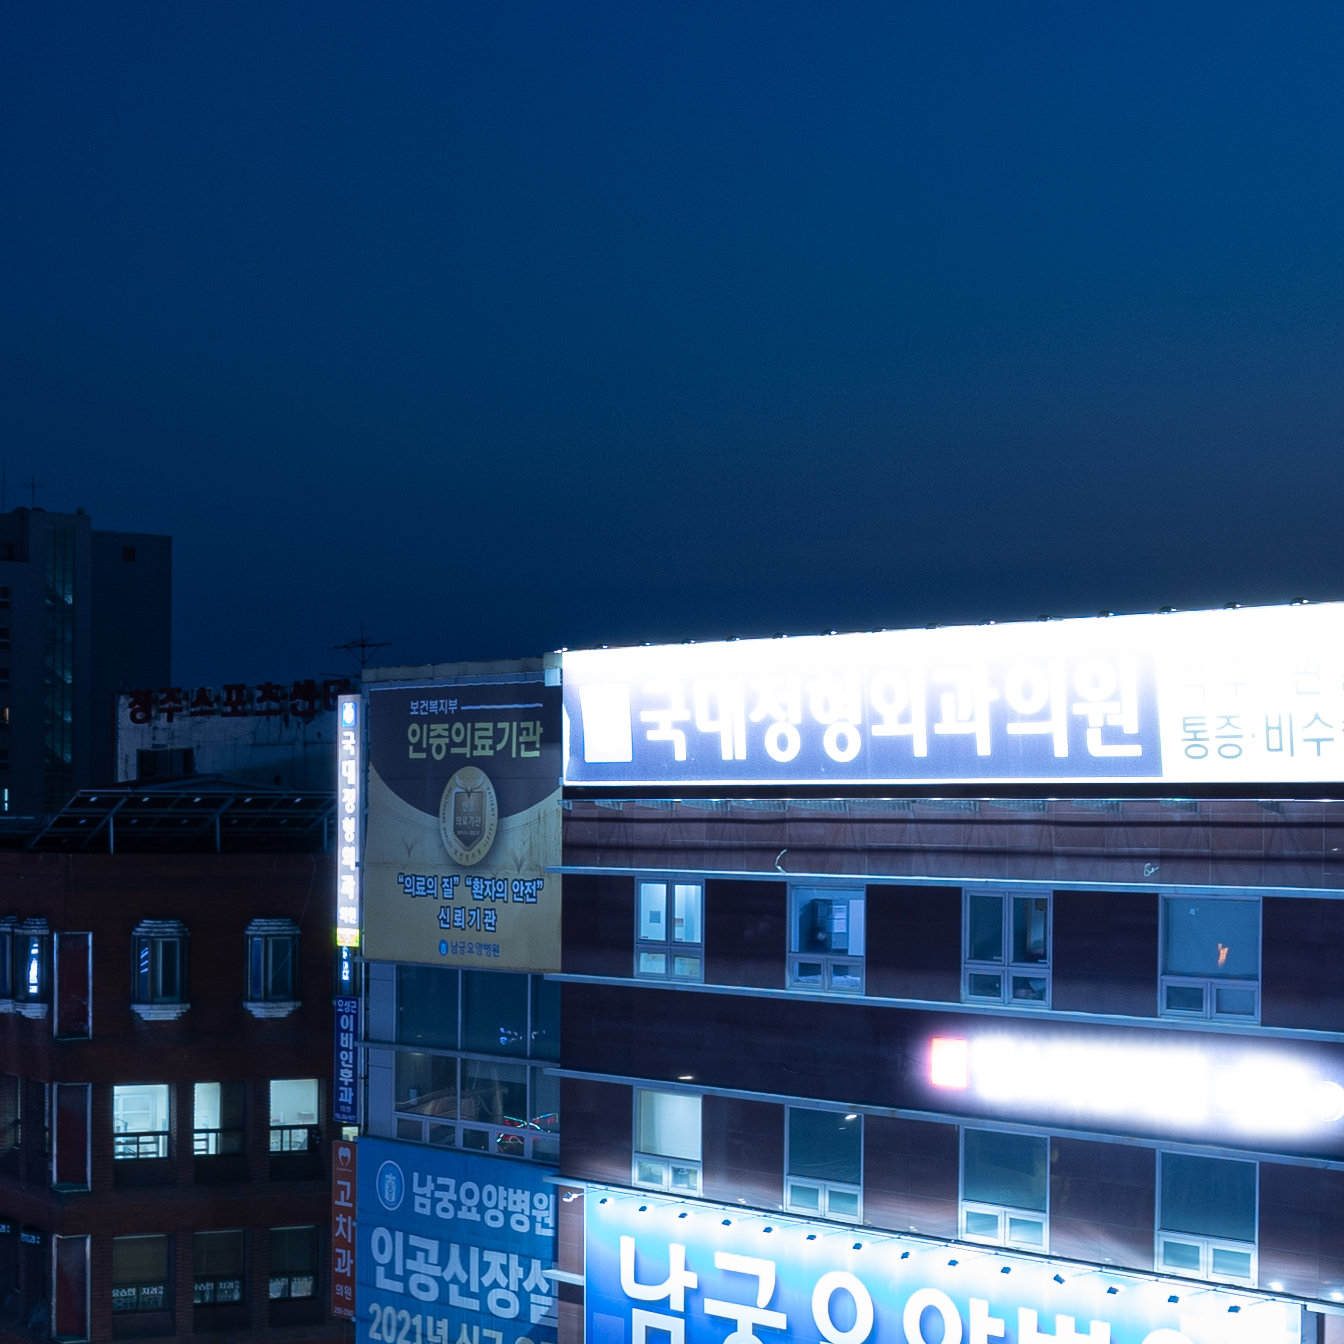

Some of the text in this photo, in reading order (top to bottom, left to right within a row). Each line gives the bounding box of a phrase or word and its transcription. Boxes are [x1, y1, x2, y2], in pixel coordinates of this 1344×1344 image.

[410, 699, 458, 716] 보건복지부
[640, 656, 1143, 762] 국대정형외과의원
[408, 720, 544, 761] 인증의료기관
[462, 802, 475, 813] 인증
[455, 815, 482, 828] 의료기관
[398, 873, 544, 904] “의료의 질” “환자의 안전”
[438, 906, 497, 931] 신뢰기관
[450, 940, 499, 957] 남궁요양병원
[337, 999, 356, 1013] 오성근
[339, 1014, 354, 1105] 이비인후과
[412, 1172, 556, 1236] 남궁요양병원
[334, 1180, 354, 1277] 고치과
[336, 1284, 352, 1300] 의원
